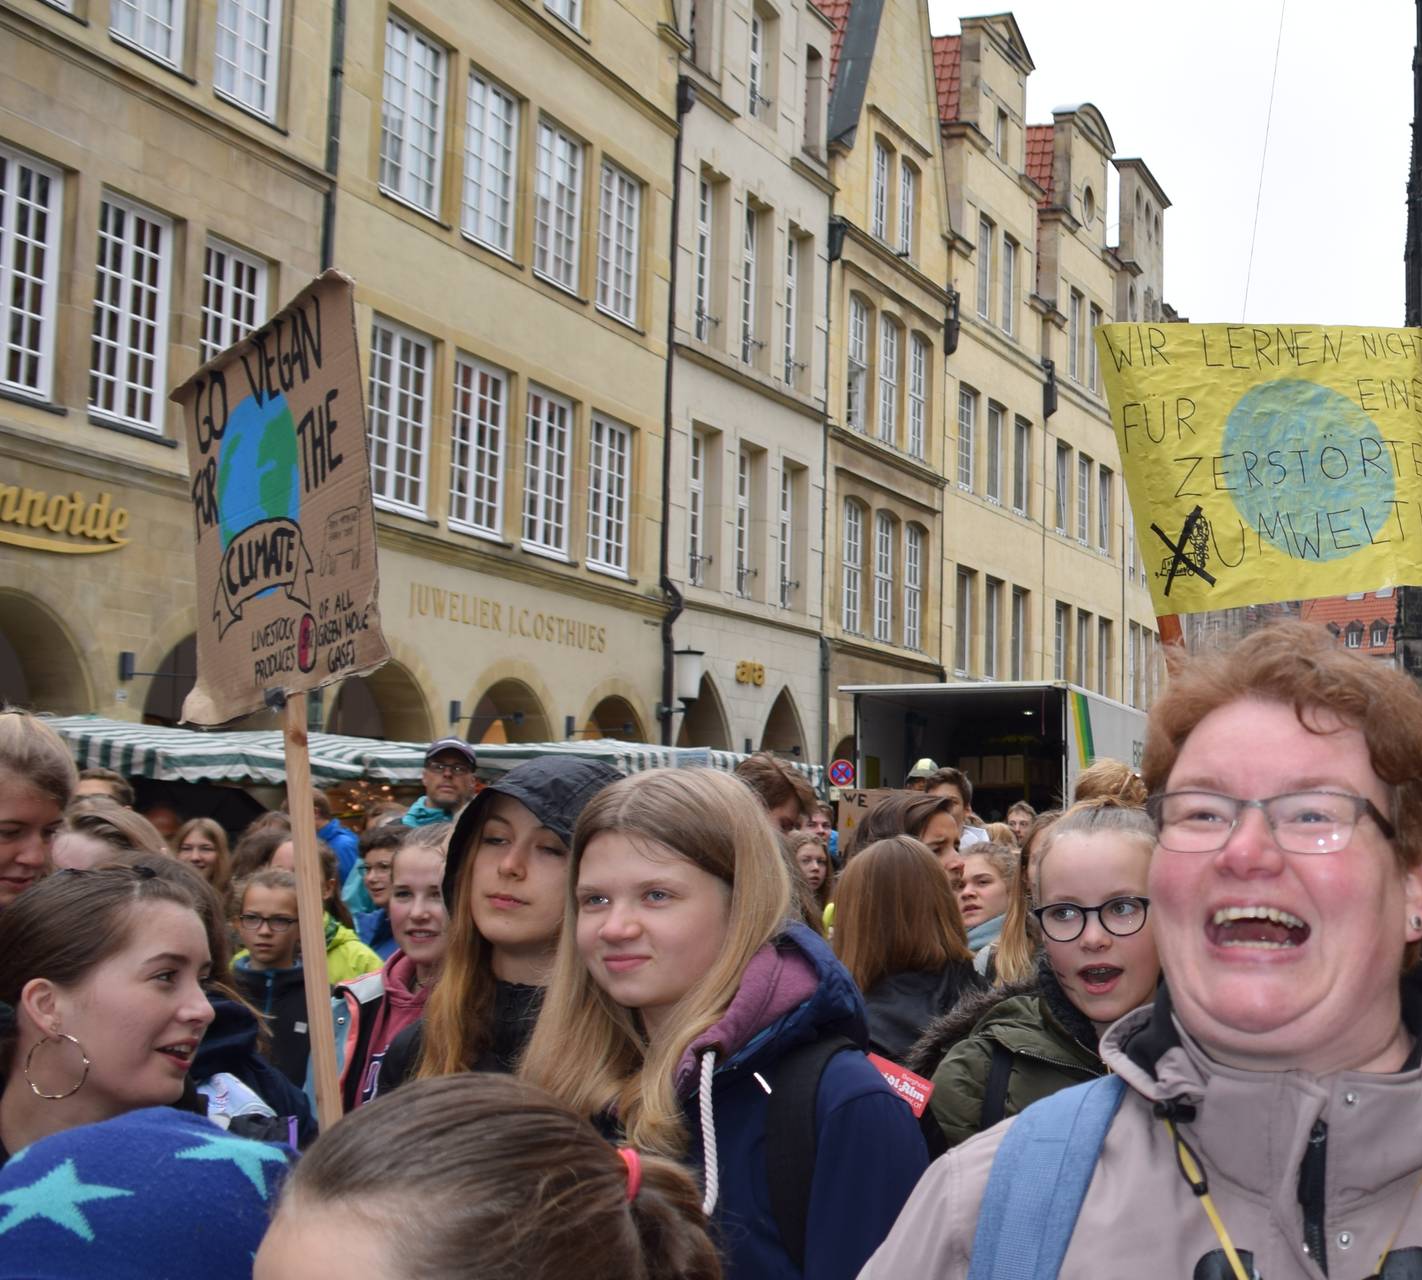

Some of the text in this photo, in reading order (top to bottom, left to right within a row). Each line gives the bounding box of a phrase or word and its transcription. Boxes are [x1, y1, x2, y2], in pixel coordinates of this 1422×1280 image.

[1102, 326, 1171, 373] WIR
[1201, 327, 1344, 370] LERNEN
[195, 295, 322, 454] GO VEGAN
[1122, 377, 1422, 453] FÜR EINE
[192, 388, 344, 544] FOR THE
[226, 527, 295, 596] CLIMATE
[319, 589, 354, 619] OF ALL
[408, 582, 502, 632] JUWELIER
[251, 616, 296, 651] LIVESTOCK
[254, 643, 296, 686] PRODUCES
[328, 640, 355, 673] GASES
[736, 660, 765, 687] ara
[843, 793, 868, 808] WE
